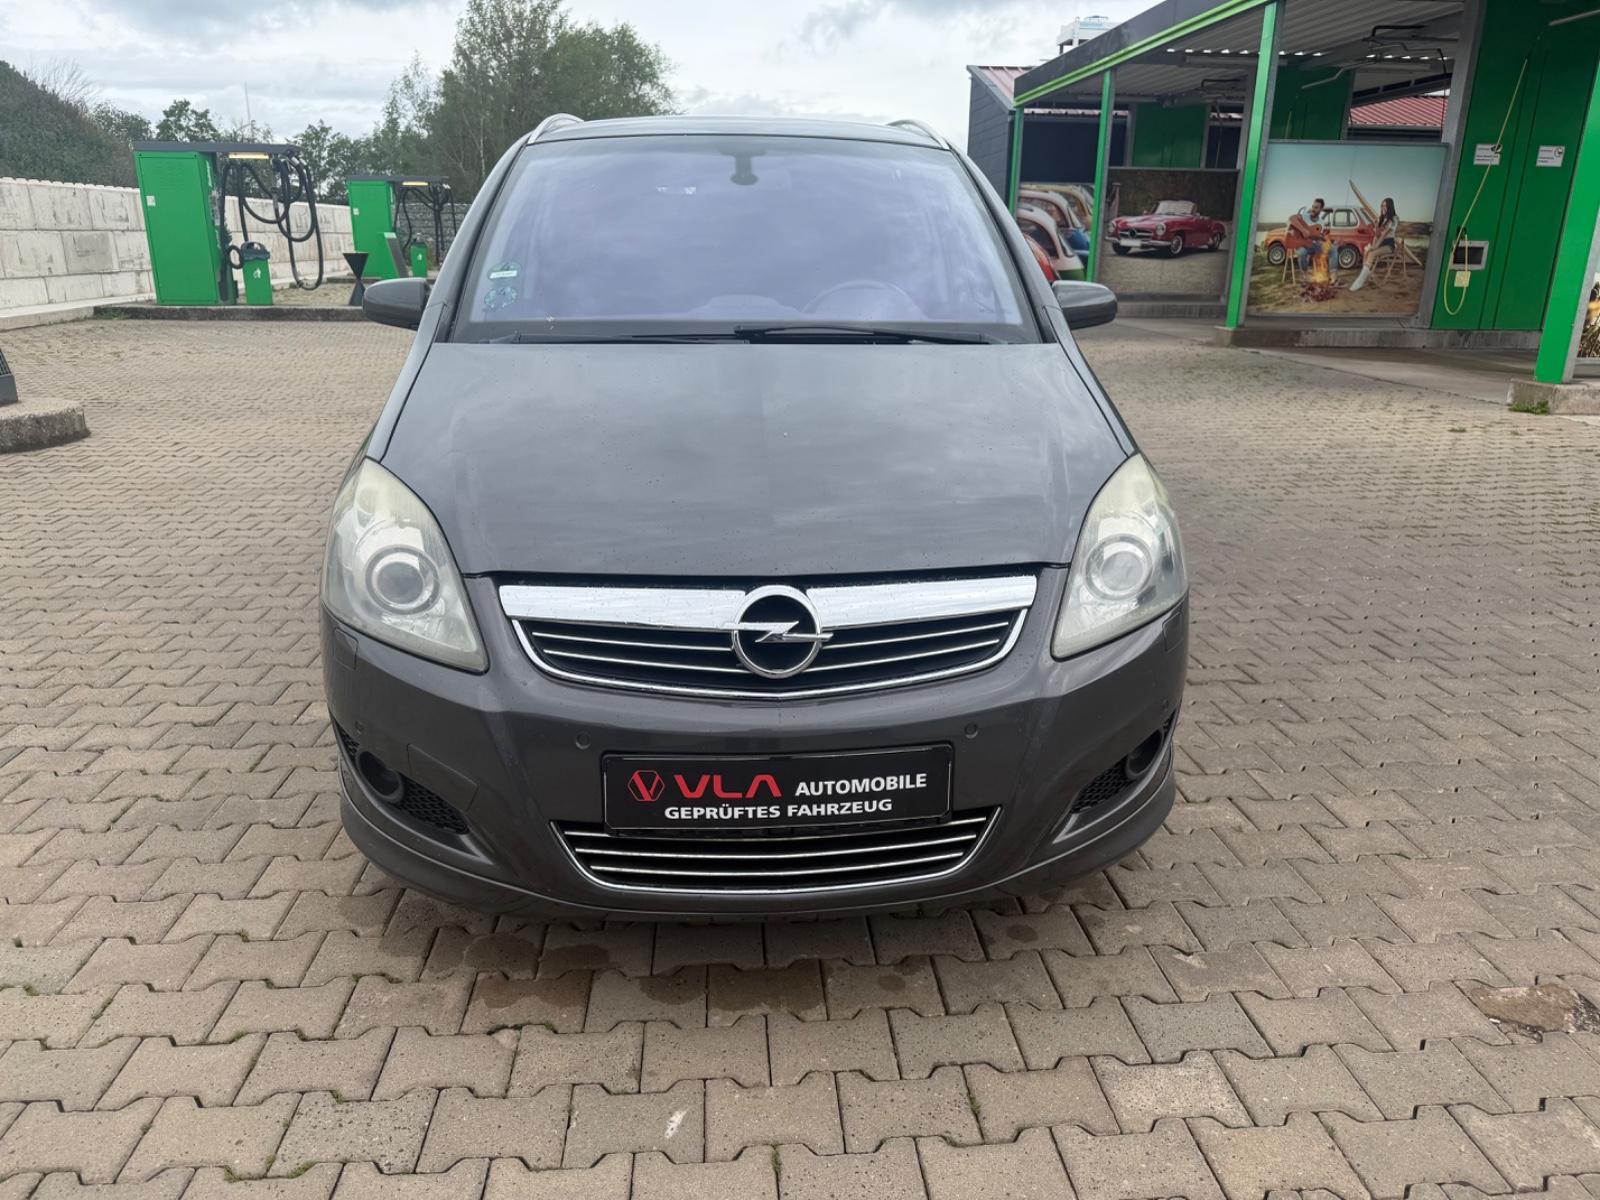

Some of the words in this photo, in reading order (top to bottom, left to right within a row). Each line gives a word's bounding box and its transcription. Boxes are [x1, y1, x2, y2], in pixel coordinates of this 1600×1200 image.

[673, 773, 782, 799] VLA
[794, 773, 927, 797] AUTOMOBILE
[664, 803, 781, 820] GEPRÜFTES
[787, 798, 893, 818] FAHRZEUG
